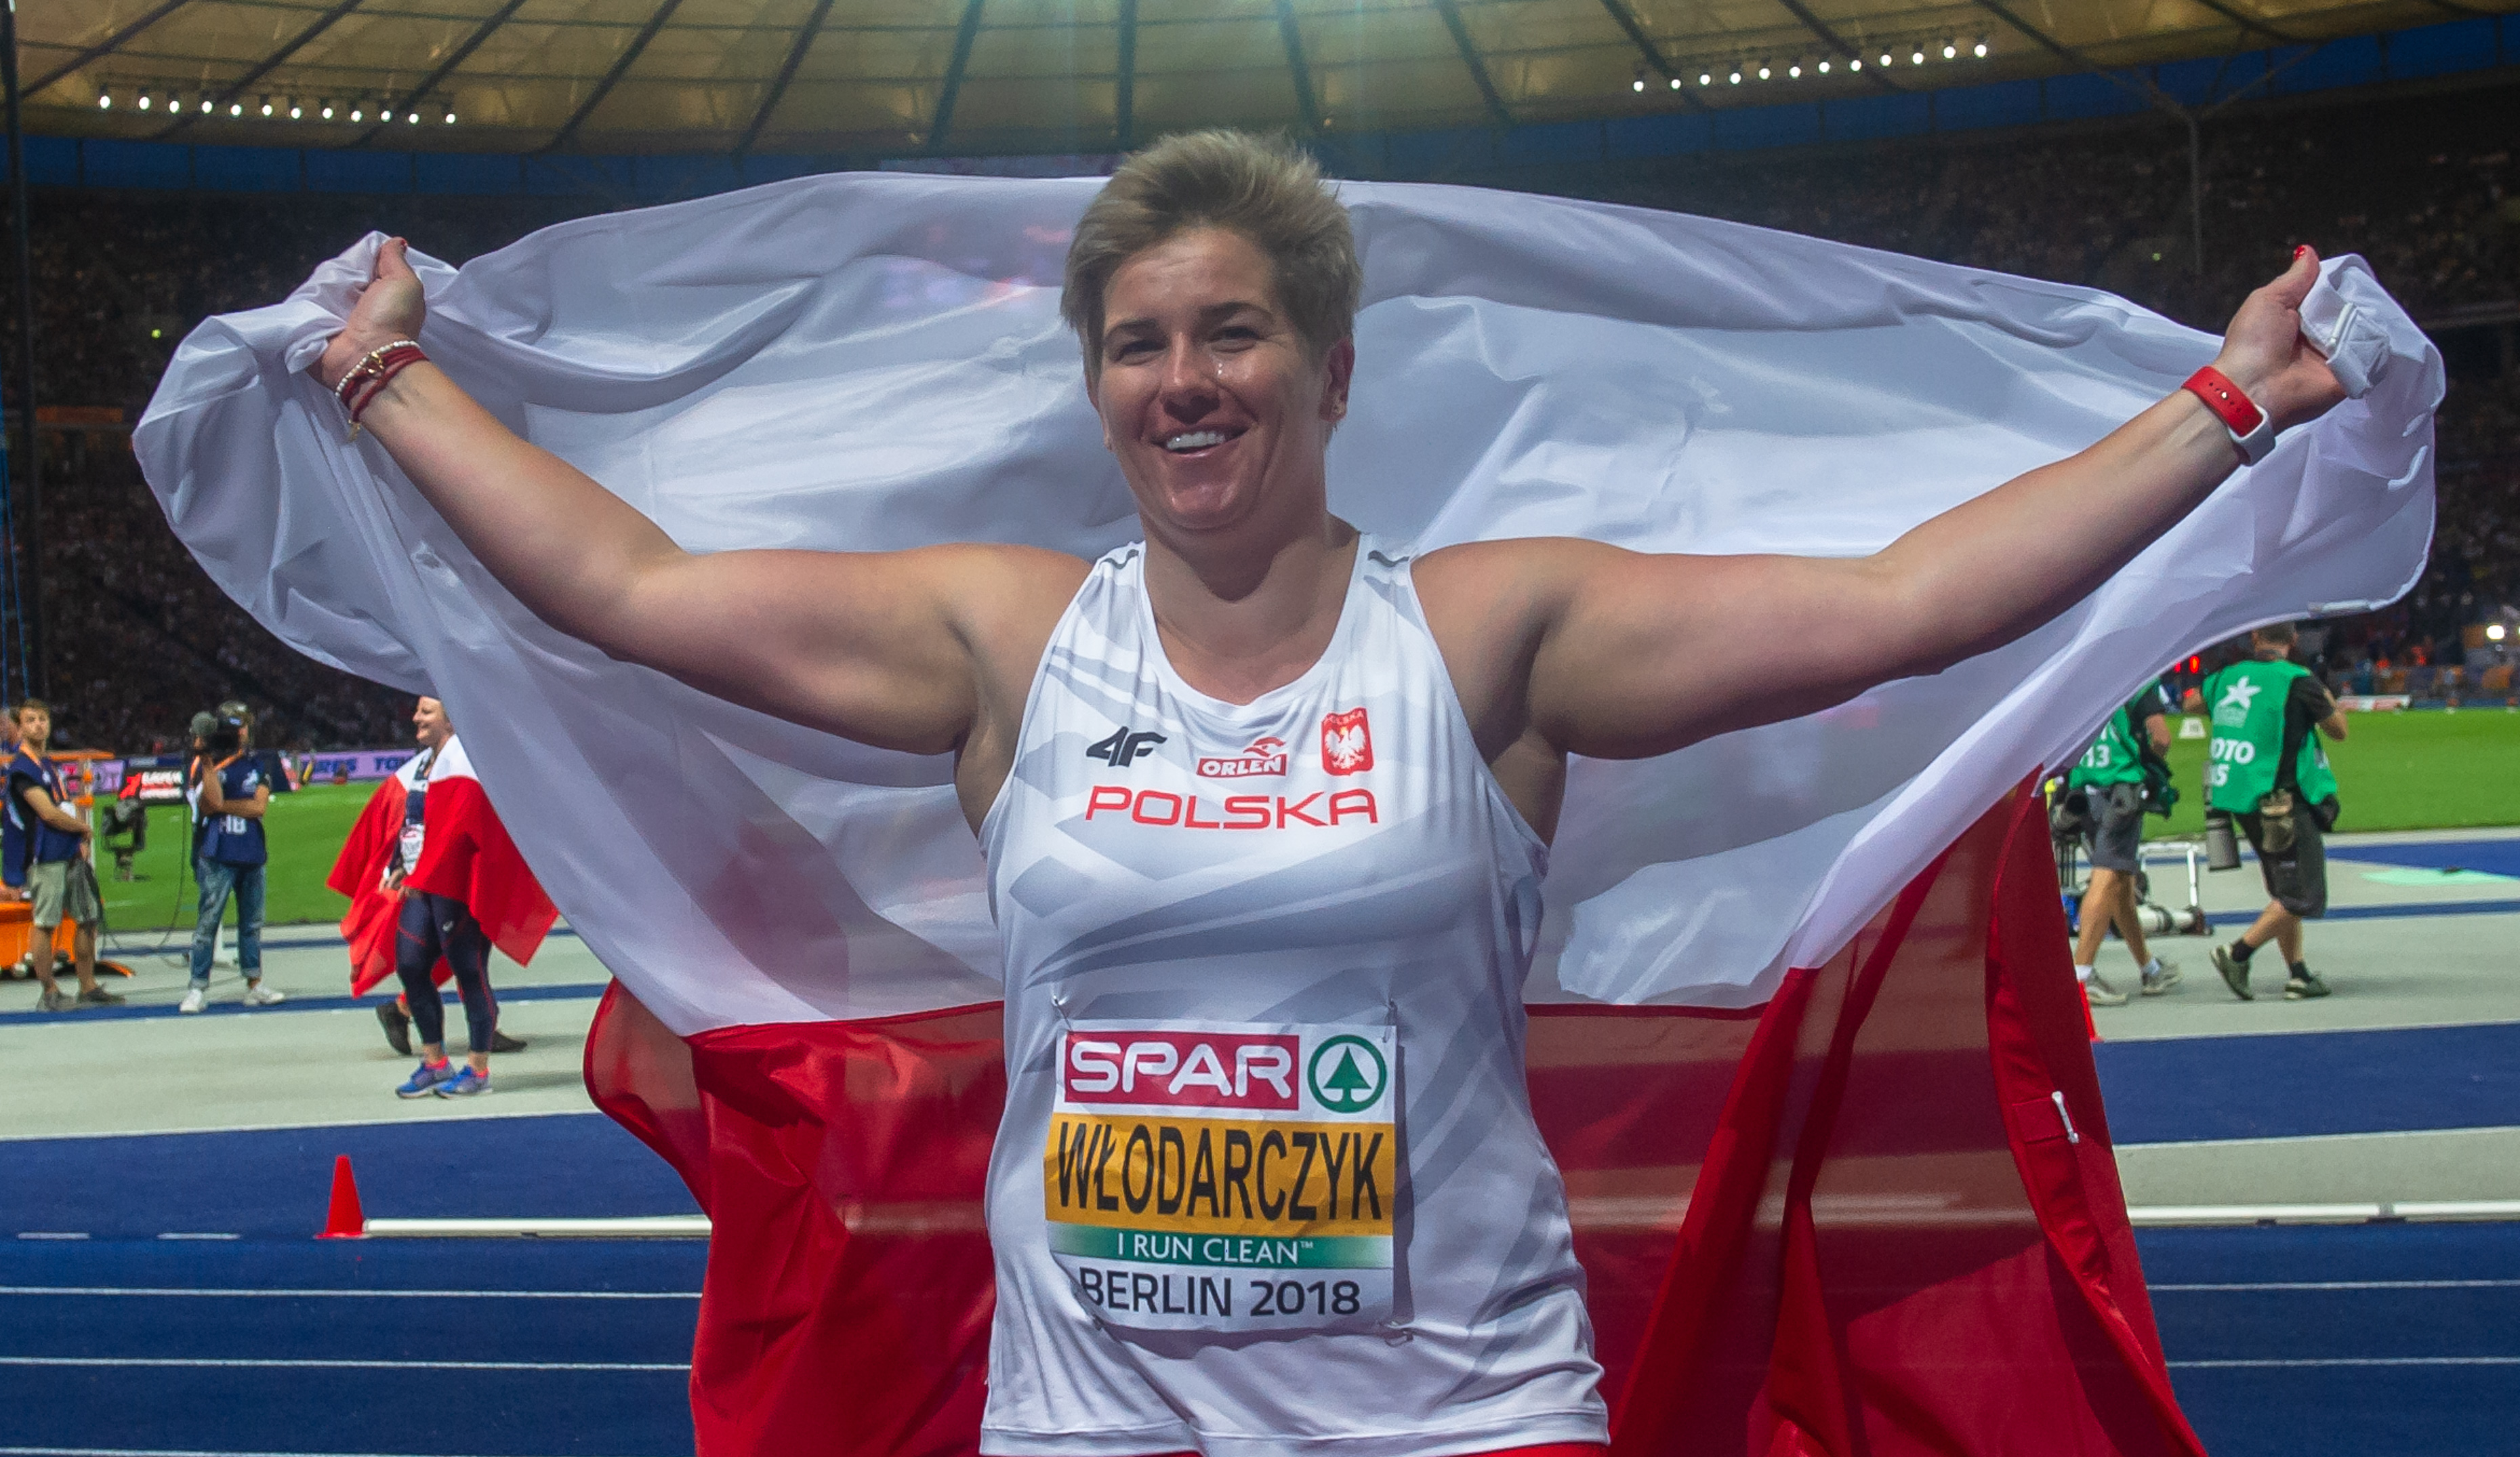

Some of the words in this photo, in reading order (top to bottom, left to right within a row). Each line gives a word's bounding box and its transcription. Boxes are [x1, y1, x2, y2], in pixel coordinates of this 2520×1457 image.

[1086, 726, 1168, 767] 4F
[1202, 758, 1282, 775] ORLEN
[1085, 785, 1379, 829] POLSKA
[1069, 1041, 1292, 1099] SPAR
[1057, 1122, 1384, 1221] WŁODARCZYK
[1117, 1233, 1124, 1256] I
[1133, 1234, 1193, 1260] RUN
[1079, 1267, 1232, 1317] BERLIN
[1249, 1280, 1362, 1316] 2018
